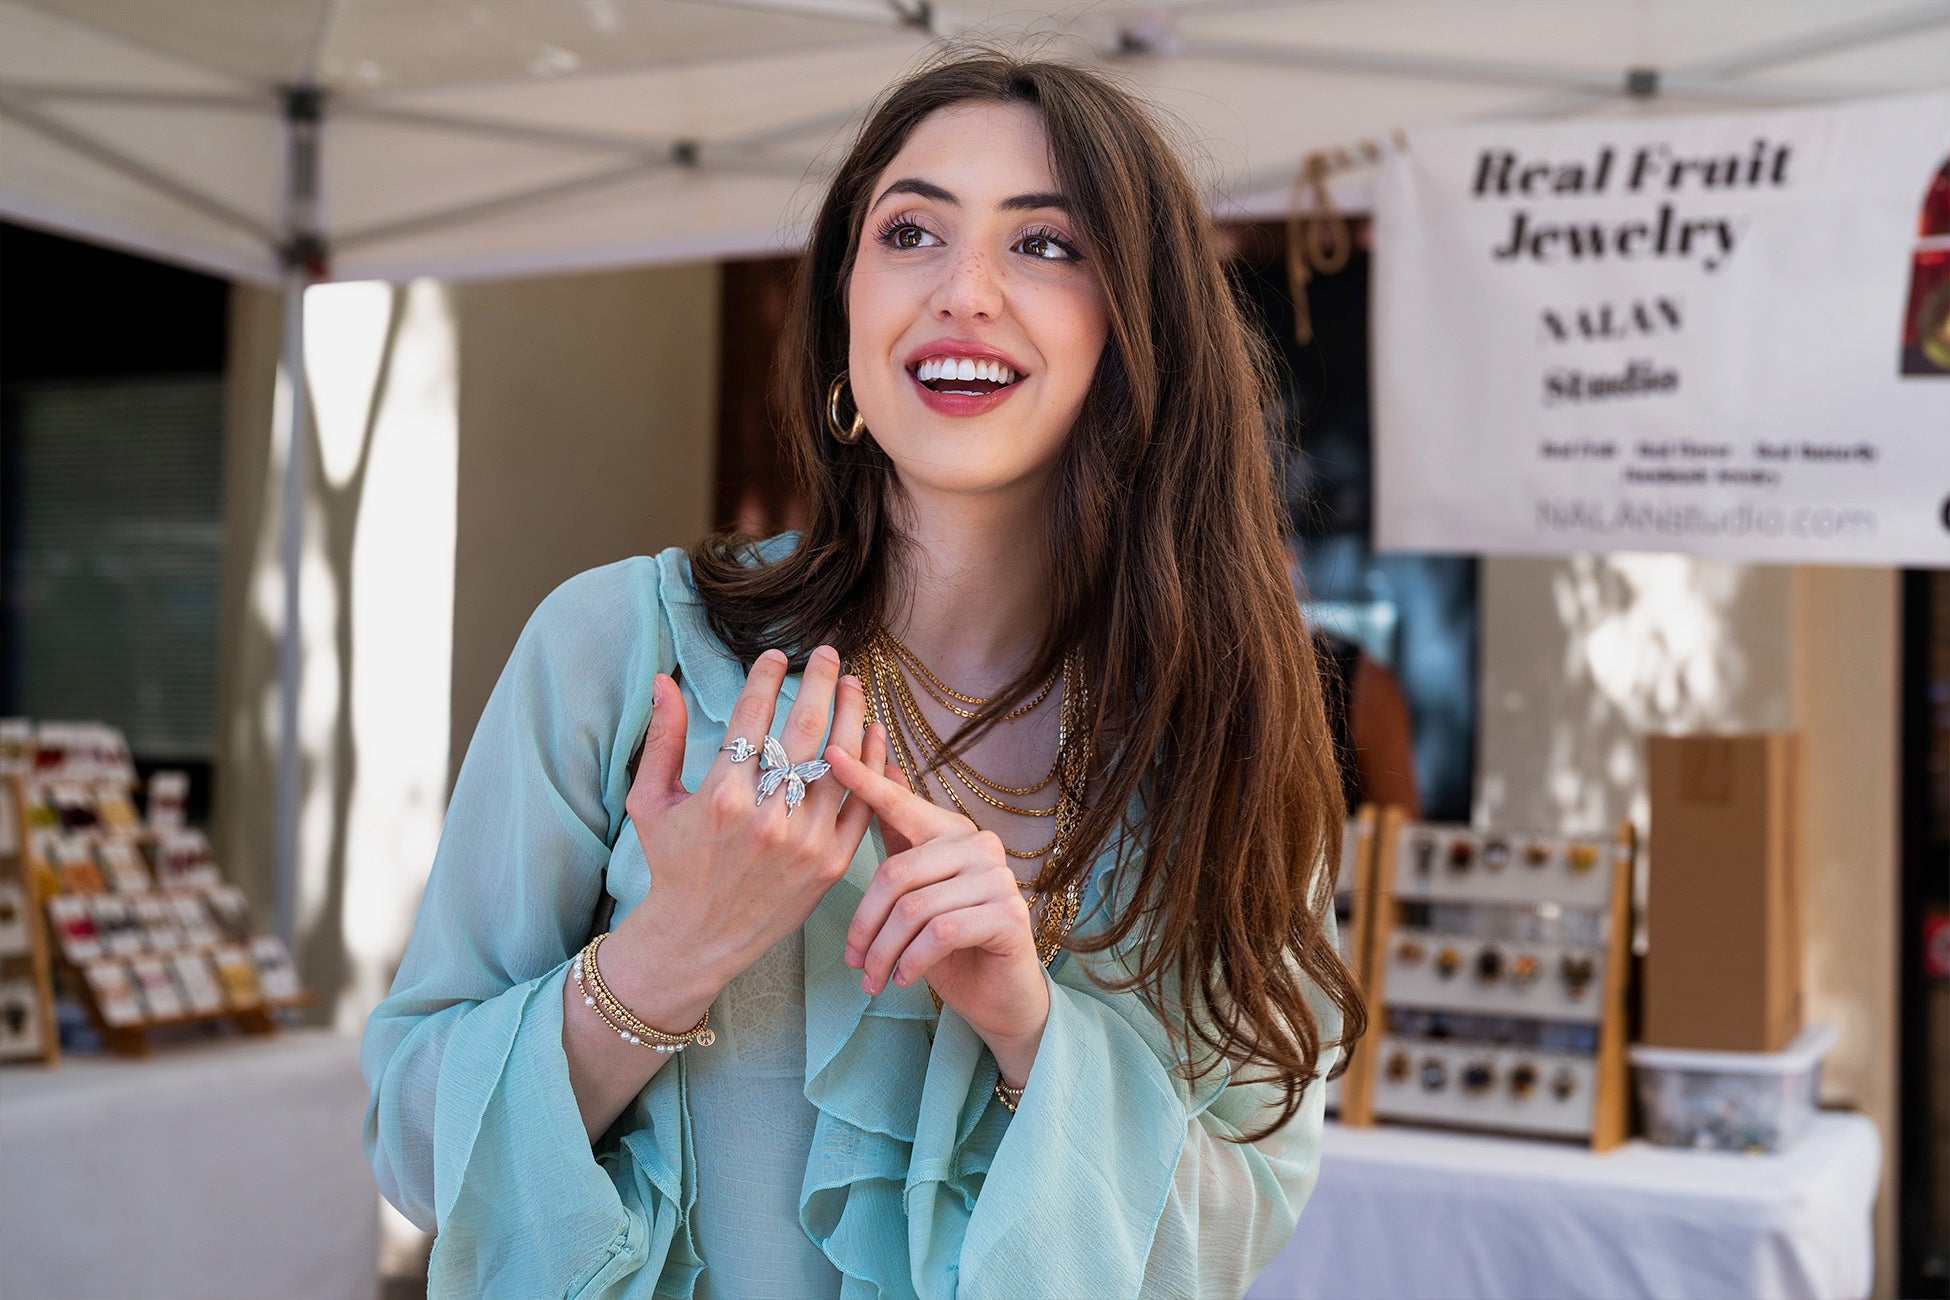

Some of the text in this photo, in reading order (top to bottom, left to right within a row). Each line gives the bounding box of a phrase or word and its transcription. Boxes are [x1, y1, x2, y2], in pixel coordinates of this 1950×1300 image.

[1471, 138, 1792, 199] Real Fruit
[1492, 204, 1742, 272] Jewelry
[1541, 298, 1683, 342] NALAN
[1542, 361, 1680, 404] Studio
